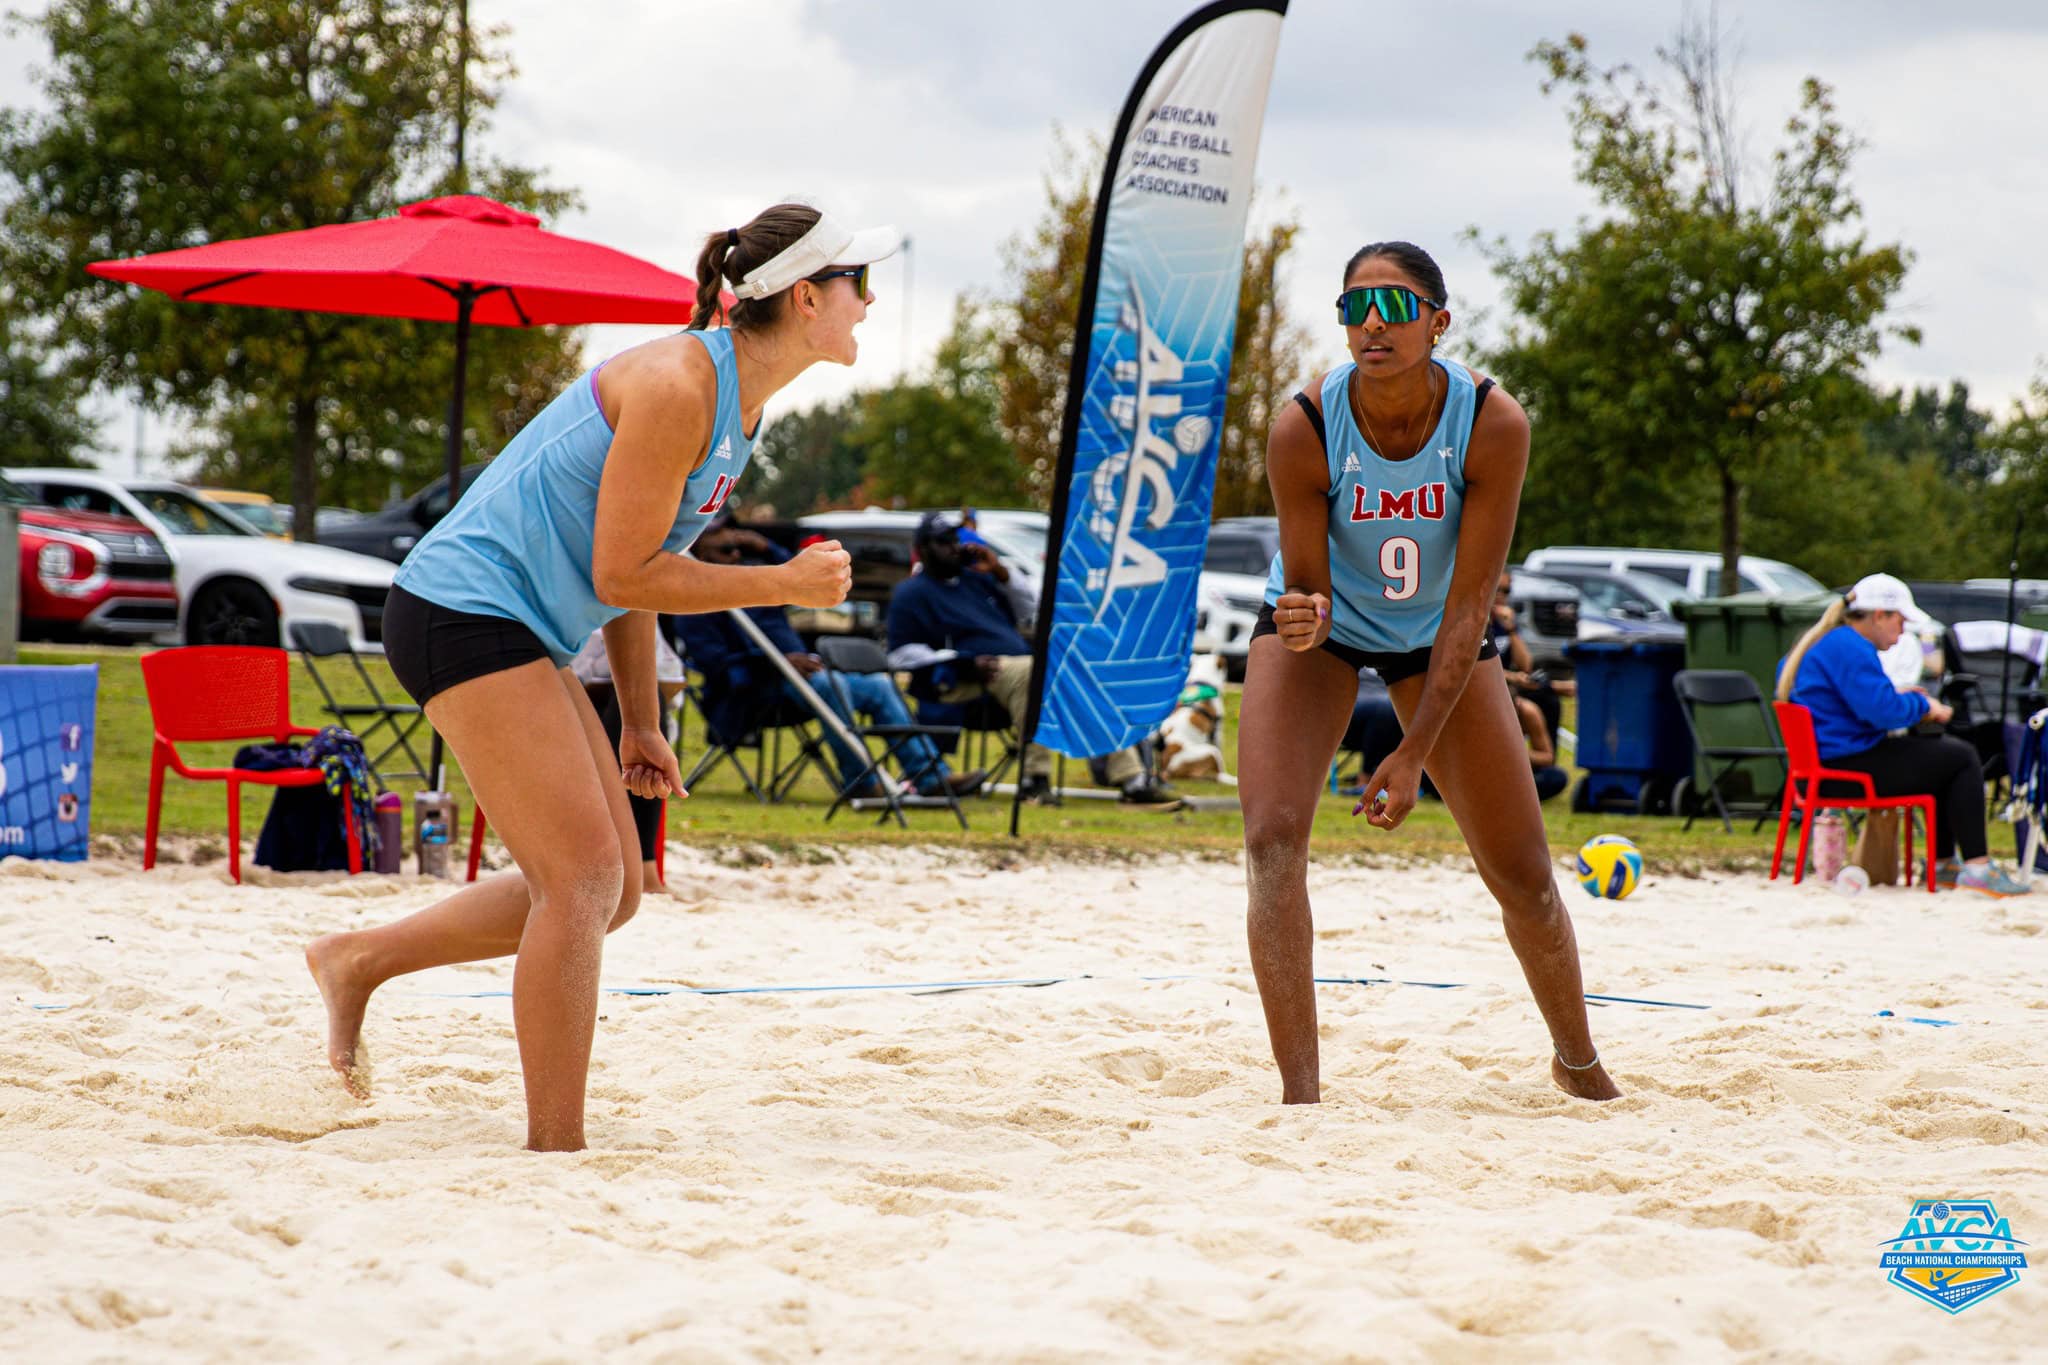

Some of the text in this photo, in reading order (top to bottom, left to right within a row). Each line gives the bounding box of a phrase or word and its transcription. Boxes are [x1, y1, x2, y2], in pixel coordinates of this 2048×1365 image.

[1137, 127, 1232, 154] OLLEYBALL
[1126, 174, 1229, 203] ASSOCIATION
[1350, 482, 1446, 522] LMU
[1378, 535, 1420, 600] 9
